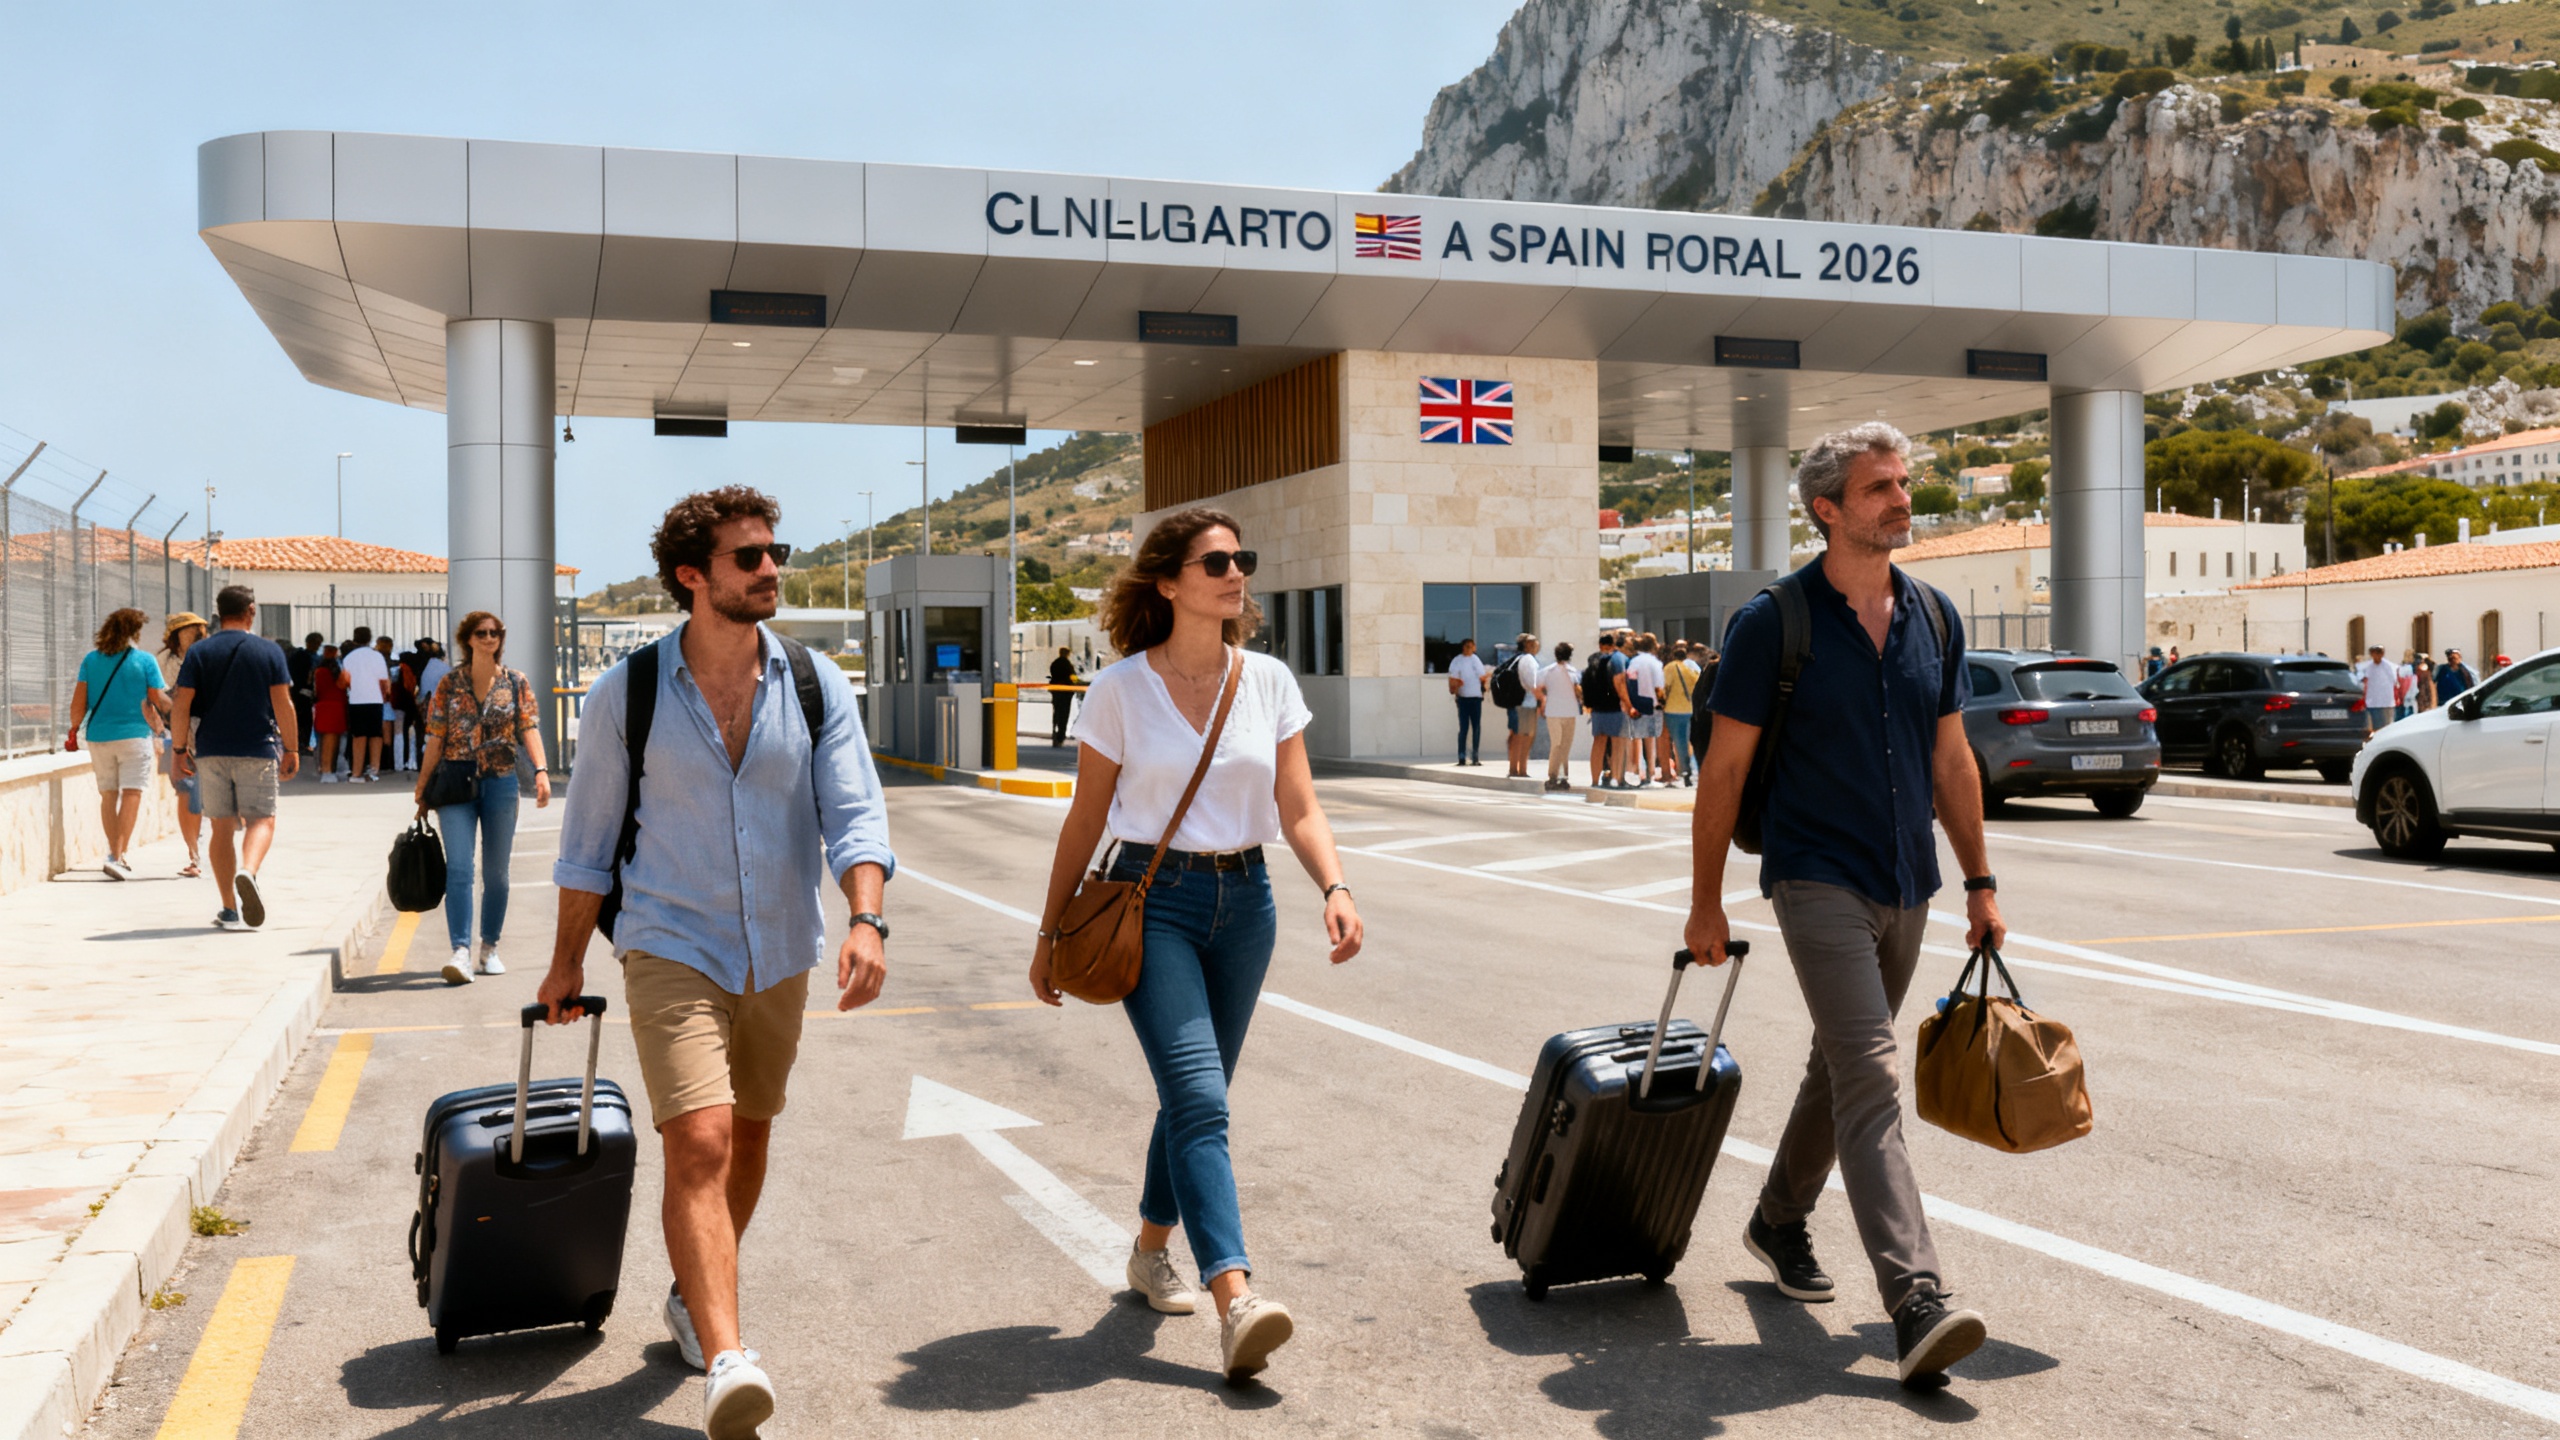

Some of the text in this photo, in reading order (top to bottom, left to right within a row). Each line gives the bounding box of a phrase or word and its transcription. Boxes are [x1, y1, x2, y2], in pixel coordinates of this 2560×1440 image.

[1441, 220, 1473, 262] A
[1488, 222, 1625, 269] SPAIN
[1818, 241, 1920, 286] 2026
